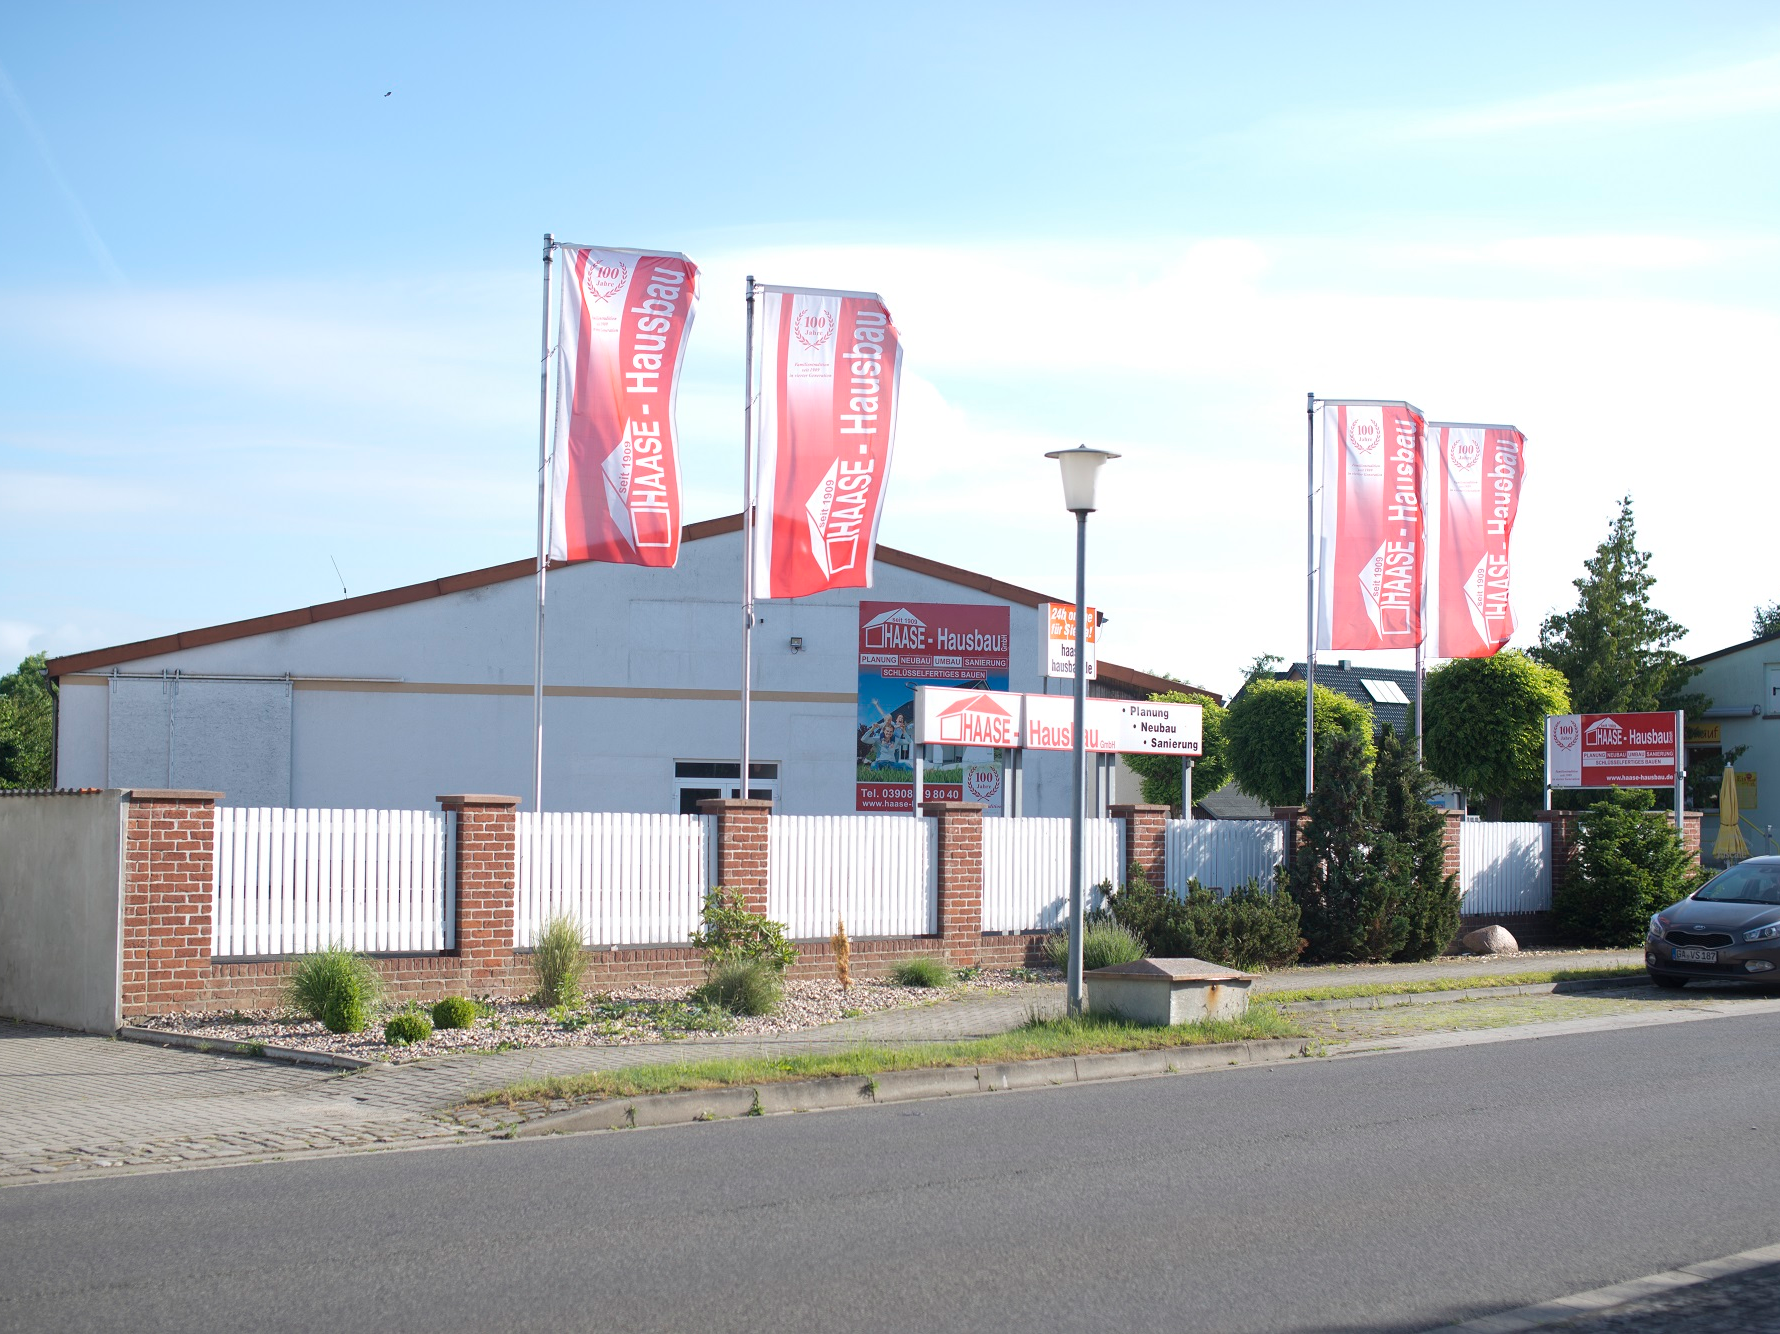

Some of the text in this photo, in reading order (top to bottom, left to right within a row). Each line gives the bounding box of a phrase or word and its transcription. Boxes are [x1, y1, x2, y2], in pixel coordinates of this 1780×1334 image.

[597, 266, 620, 279] 100
[804, 316, 826, 328] 100
[625, 267, 686, 393] Hausbau
[840, 310, 887, 434] Hausbau
[1357, 425, 1374, 435] 100
[1458, 445, 1474, 454] 100
[619, 441, 632, 494] seit 1909
[631, 421, 668, 507] HAASE
[819, 480, 834, 528] seit 1909
[826, 459, 874, 538] HAASE
[1374, 556, 1384, 577] 1909
[1380, 541, 1414, 606] HAASE
[1051, 606, 1066, 620] 24h
[1051, 624, 1062, 635] für
[884, 624, 926, 650] HAASE
[938, 628, 1000, 652] Hausbau
[862, 656, 896, 664] PLANUNG
[965, 659, 1006, 667] SANIERUNG
[883, 668, 959, 678] SCHLÜSSELFERTIGES
[1130, 706, 1169, 719] Planung
[963, 713, 1010, 744] HAASE
[1030, 720, 1098, 748] Hausu
[1100, 740, 1115, 748] GmbH
[1141, 722, 1176, 733] Neubau
[1560, 726, 1573, 734] 100
[1598, 729, 1622, 745] HAASE
[1630, 728, 1669, 745] Hausbau
[1151, 738, 1198, 751] Sanierung
[976, 772, 993, 783] 100
[861, 788, 879, 798] Tel.
[933, 790, 945, 798] 80
[947, 790, 958, 799] 40
[1702, 952, 1715, 961] 187
